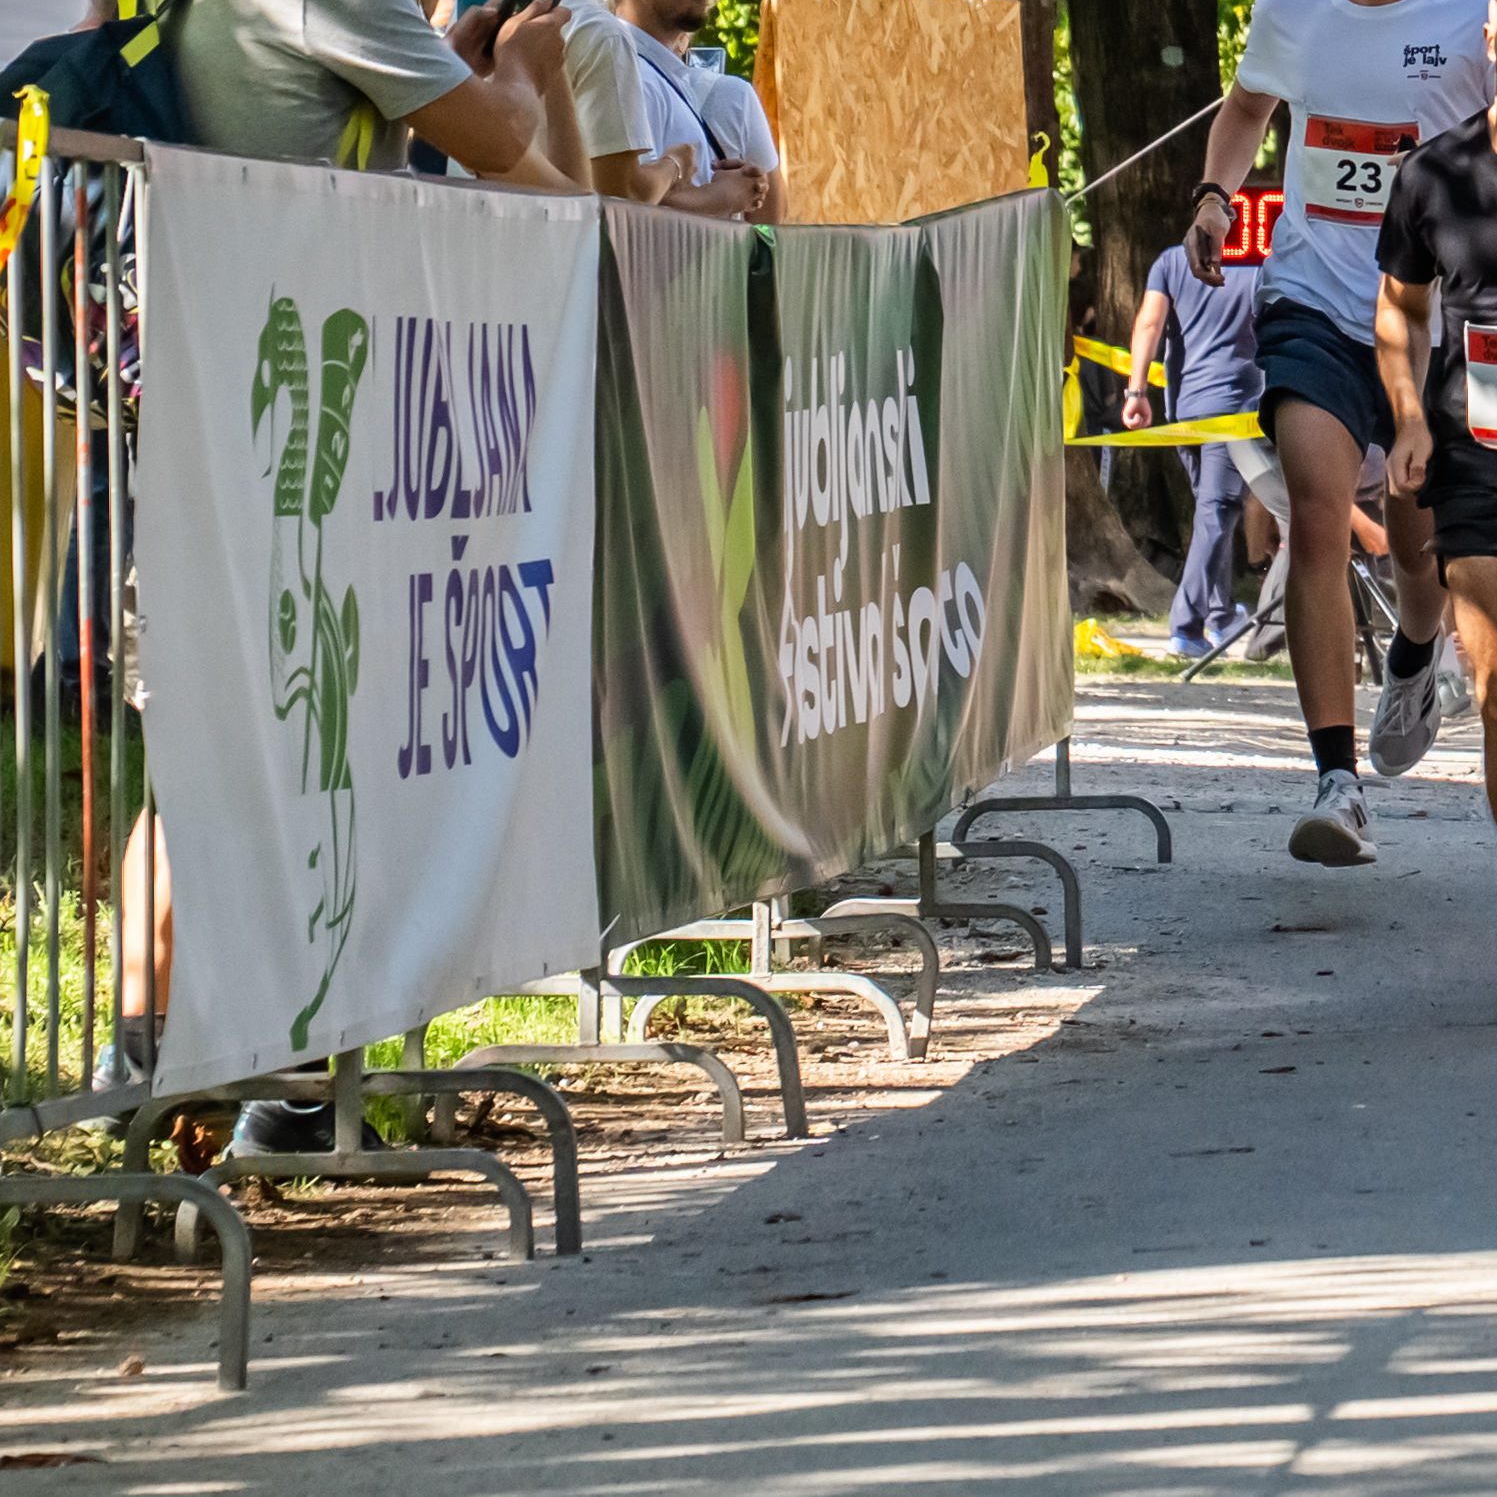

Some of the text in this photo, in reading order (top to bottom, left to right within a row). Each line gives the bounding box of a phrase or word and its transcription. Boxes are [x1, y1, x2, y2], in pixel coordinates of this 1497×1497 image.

[1403, 44, 1441, 56] šport
[1403, 54, 1447, 67] je lajv
[1336, 159, 1382, 194] 23
[397, 534, 554, 779] JE ŠPORT
